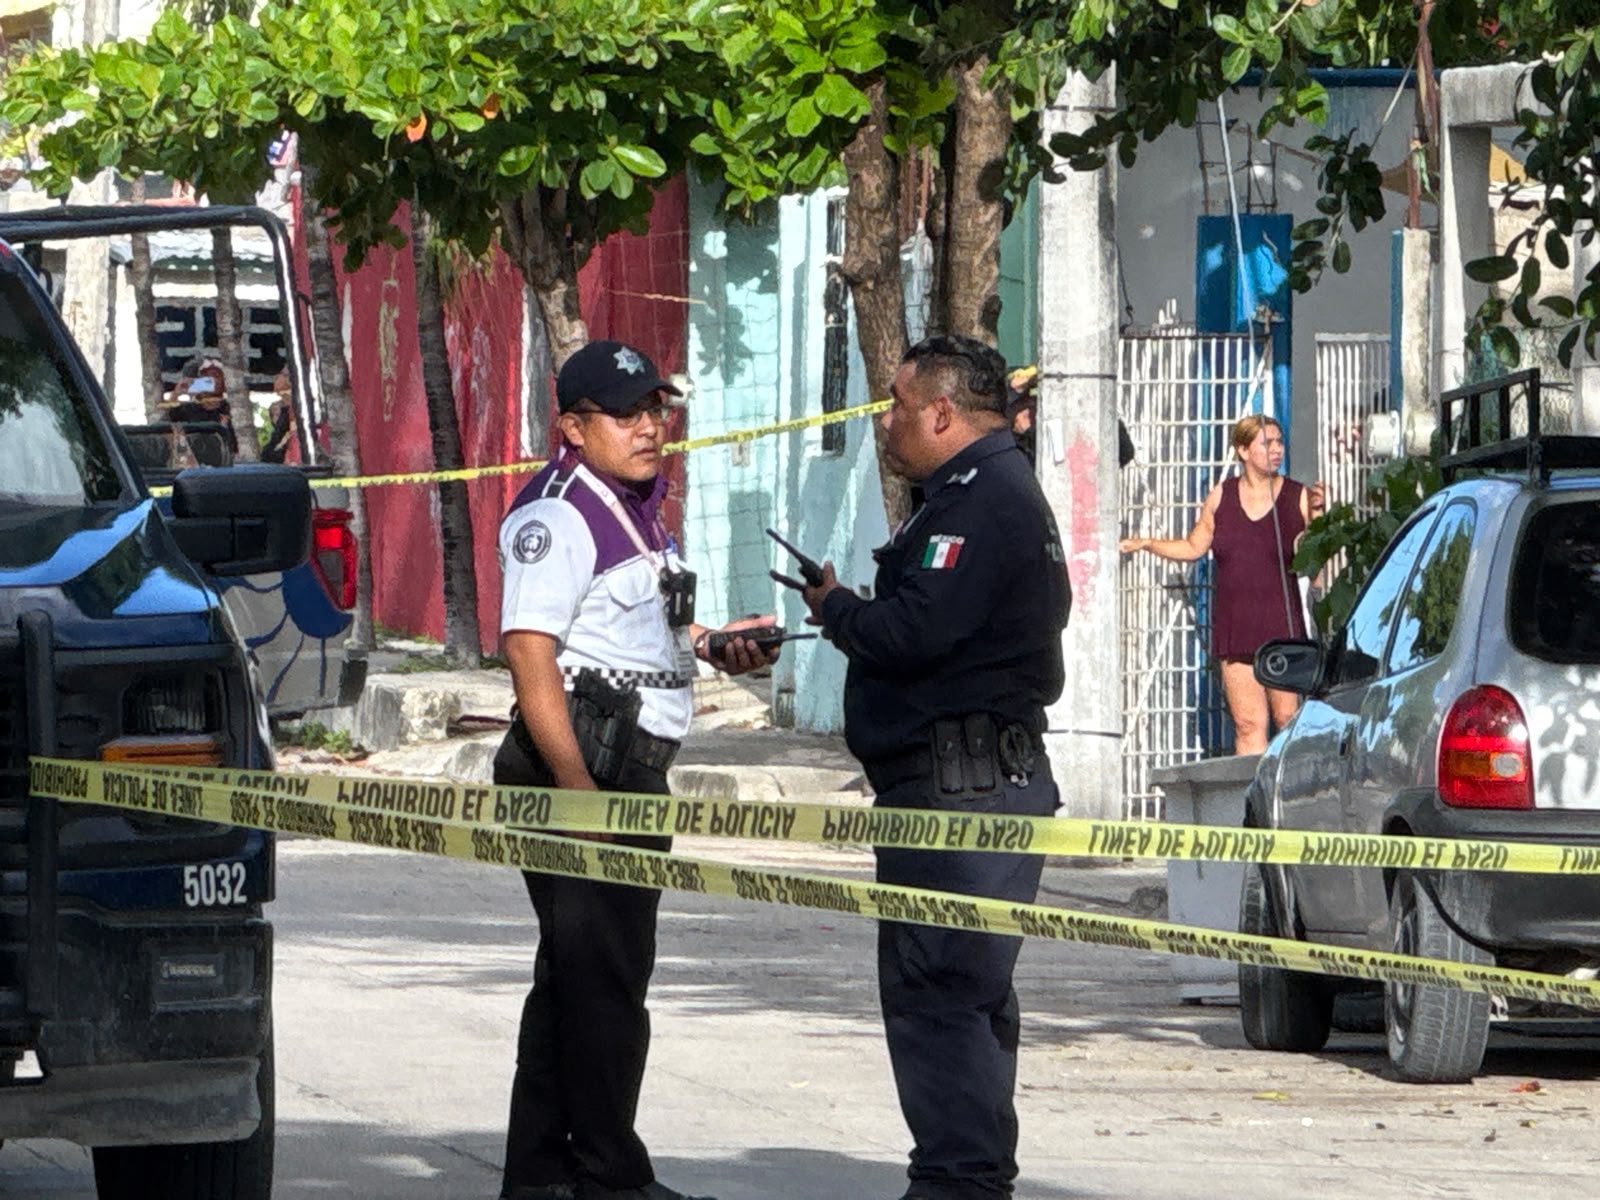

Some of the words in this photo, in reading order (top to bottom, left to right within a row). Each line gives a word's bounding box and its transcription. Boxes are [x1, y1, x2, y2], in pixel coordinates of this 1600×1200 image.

[103, 771, 148, 807] POLICIA
[152, 780, 167, 812] DE
[184, 862, 247, 907] 5032
